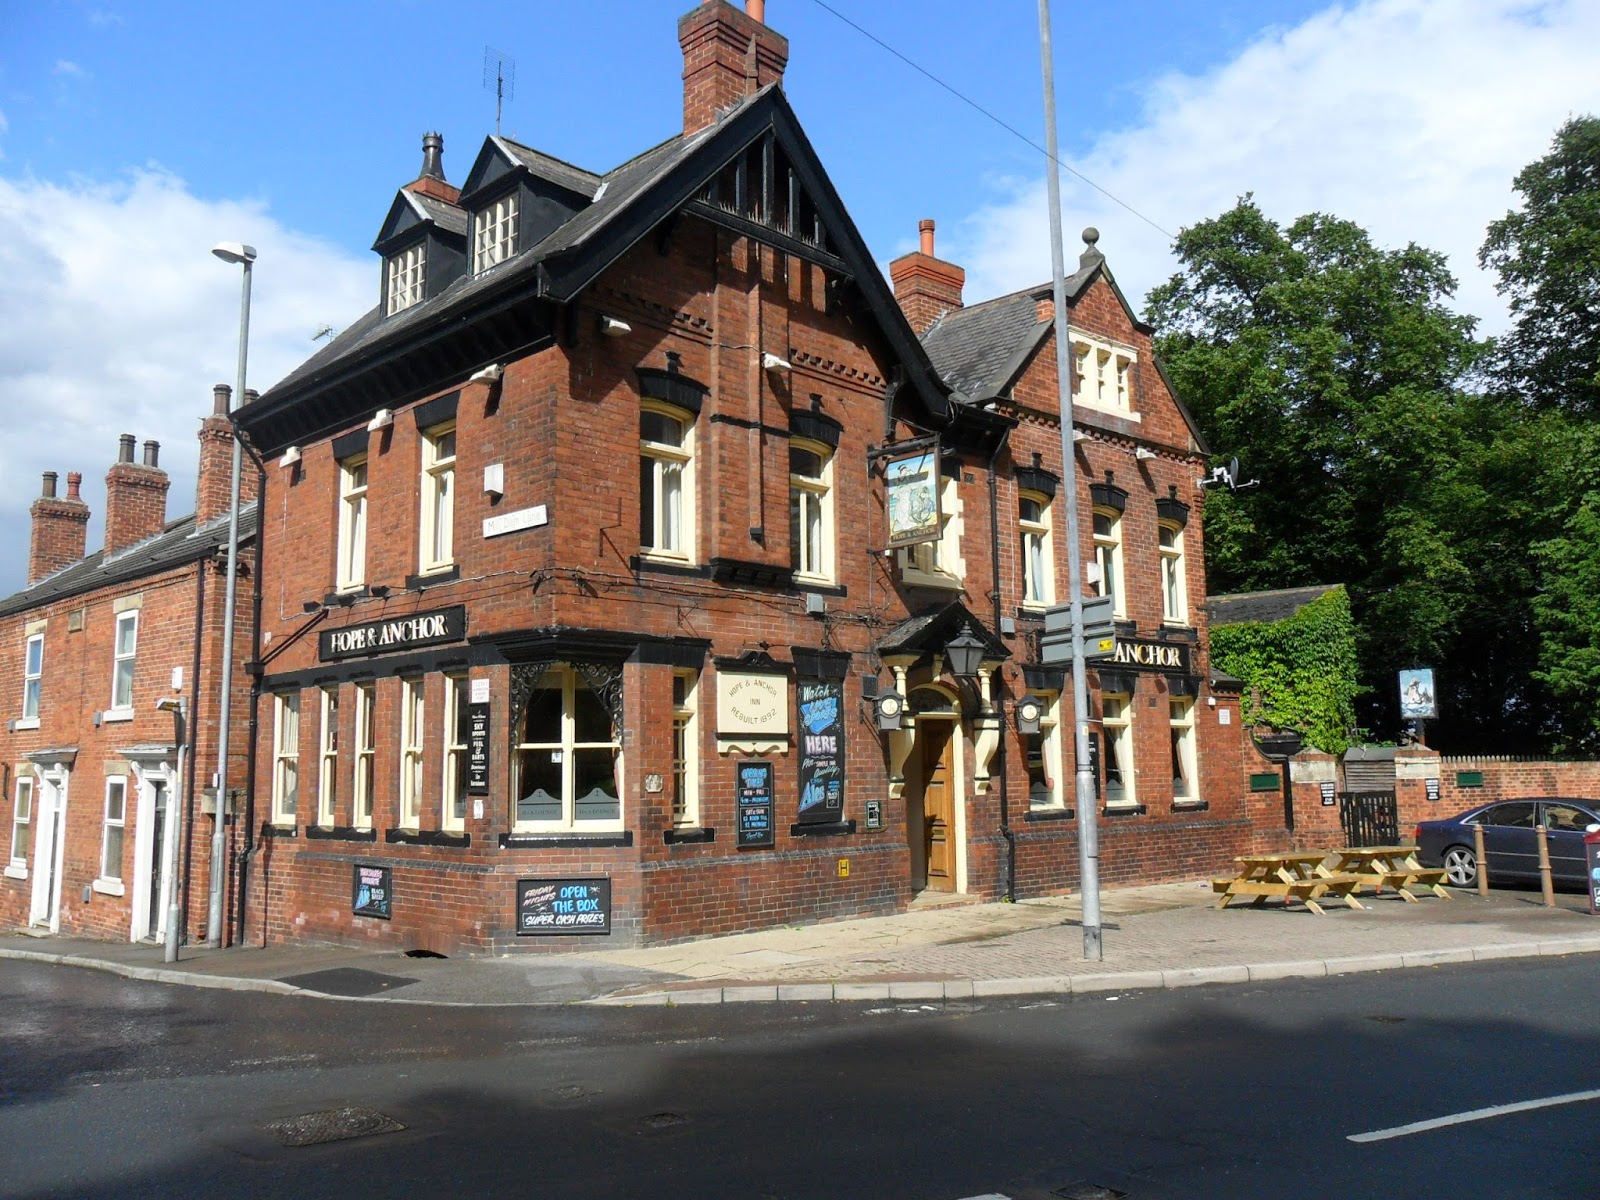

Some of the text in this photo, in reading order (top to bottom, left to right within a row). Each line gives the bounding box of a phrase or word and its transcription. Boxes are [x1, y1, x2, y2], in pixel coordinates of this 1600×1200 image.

[331, 615, 450, 653] HOPE & ANCHOR
[1114, 642, 1181, 666] ANCHOR
[728, 679, 778, 698] HOPE & ANCHOR
[803, 684, 831, 702] Watch
[749, 698, 761, 706] INN
[731, 706, 778, 725] REBUILT 1892
[805, 735, 838, 755] HERE
[522, 892, 556, 907] NIGHTS
[524, 885, 555, 898] FRIDAY
[560, 885, 588, 899] OPEN
[551, 898, 599, 913] THE BOX
[524, 913, 605, 926] SUPER CASH PRIZES
